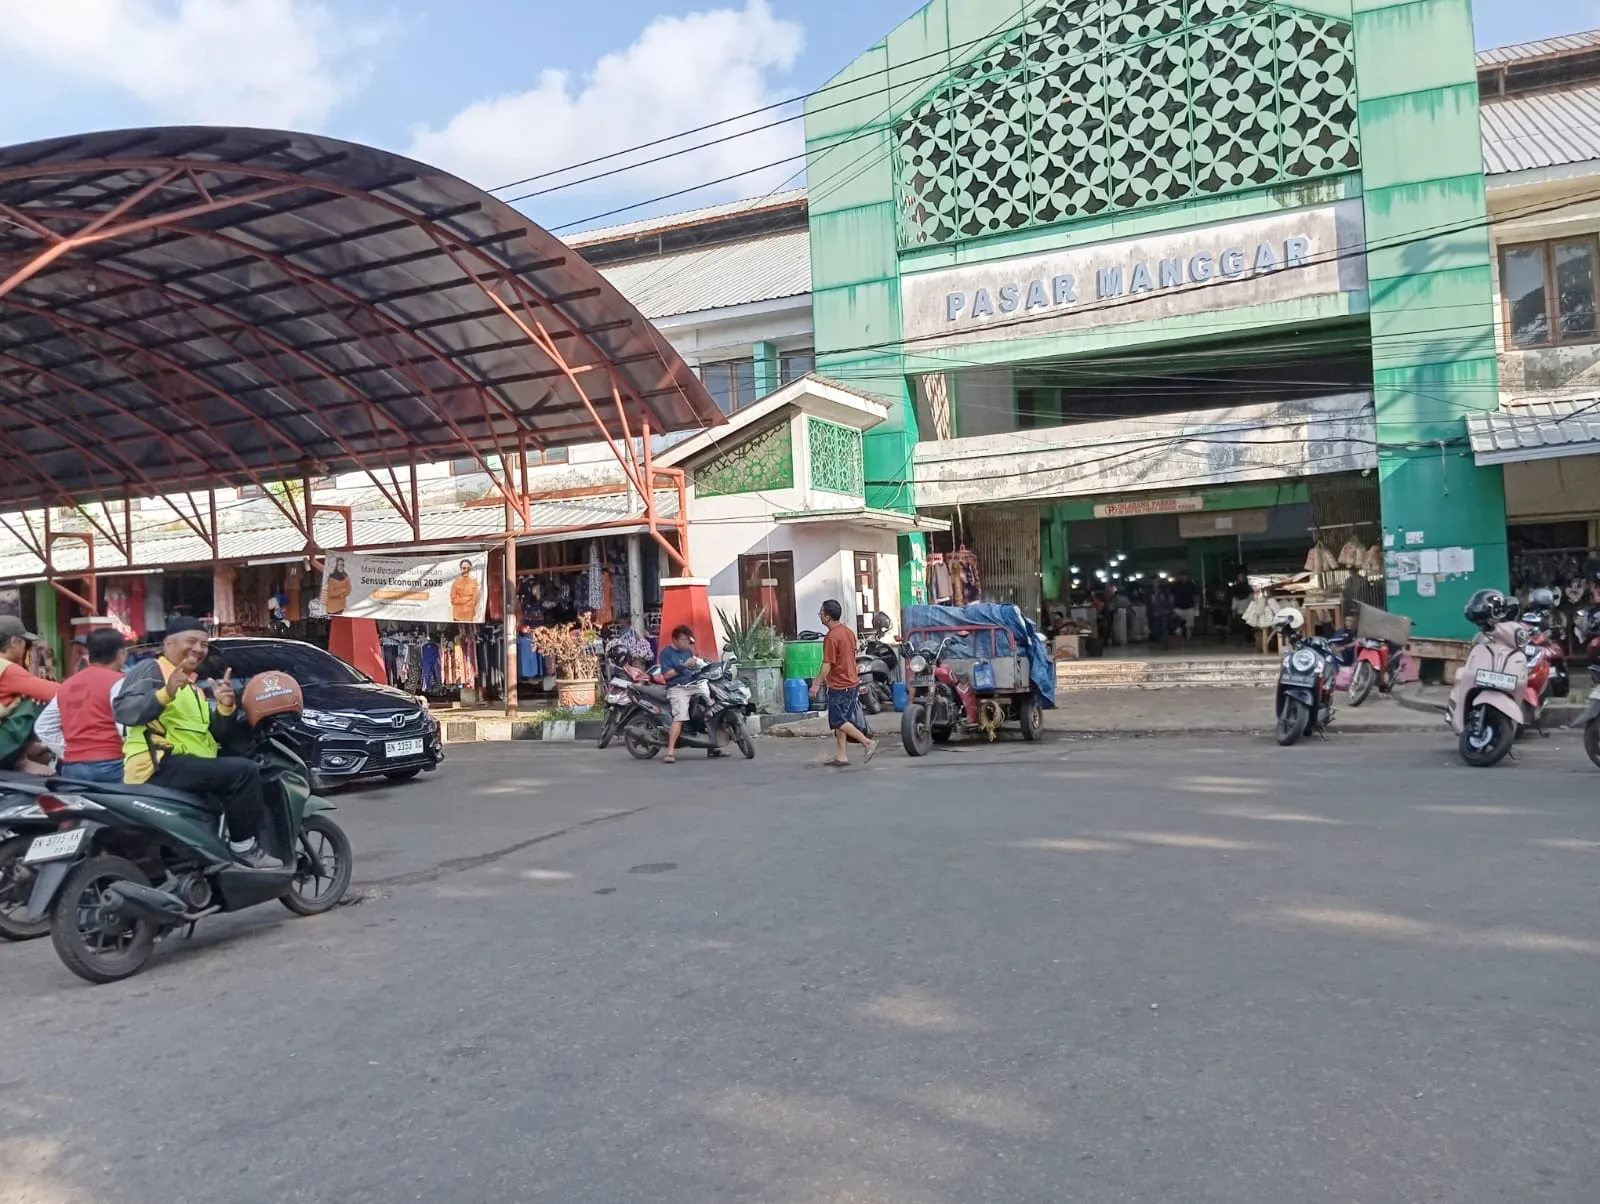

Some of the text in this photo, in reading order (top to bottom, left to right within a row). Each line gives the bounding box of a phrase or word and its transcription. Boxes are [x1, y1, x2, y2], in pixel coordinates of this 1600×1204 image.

[945, 236, 1311, 322] PASAR MANGGAR
[360, 576, 443, 587] Sensus Ekonomi 2026
